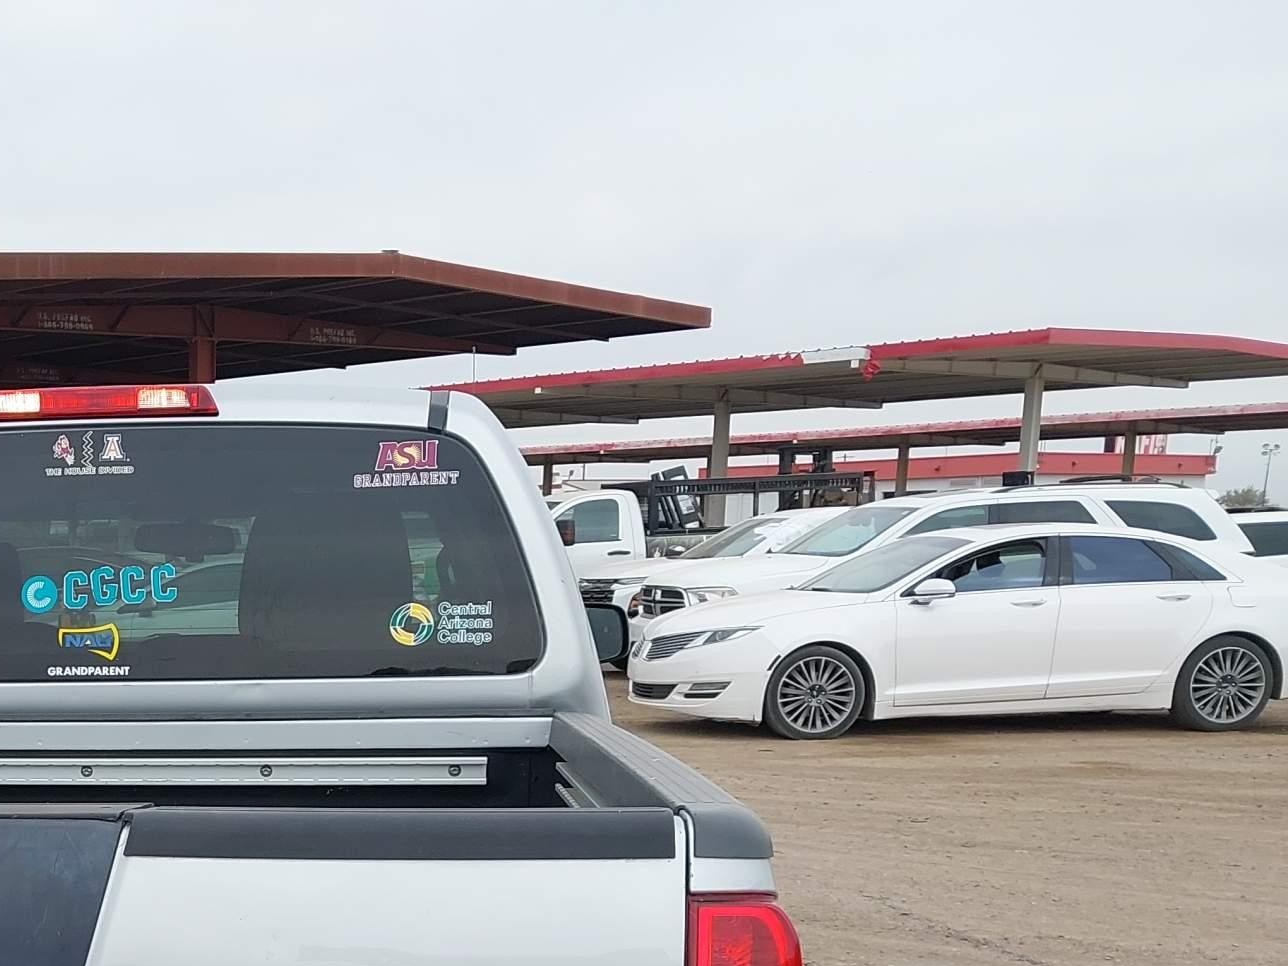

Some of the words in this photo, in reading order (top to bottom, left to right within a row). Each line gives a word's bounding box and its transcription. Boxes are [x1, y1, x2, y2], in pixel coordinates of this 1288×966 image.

[375, 440, 438, 470] ASU
[64, 466, 96, 475] HOUSE
[353, 470, 460, 488] GRANDPARENT
[63, 563, 178, 610] CGCC
[437, 601, 492, 616] Central
[437, 615, 493, 630] Arizona
[437, 629, 492, 646] College
[47, 666, 130, 676] GRANDPARENT
